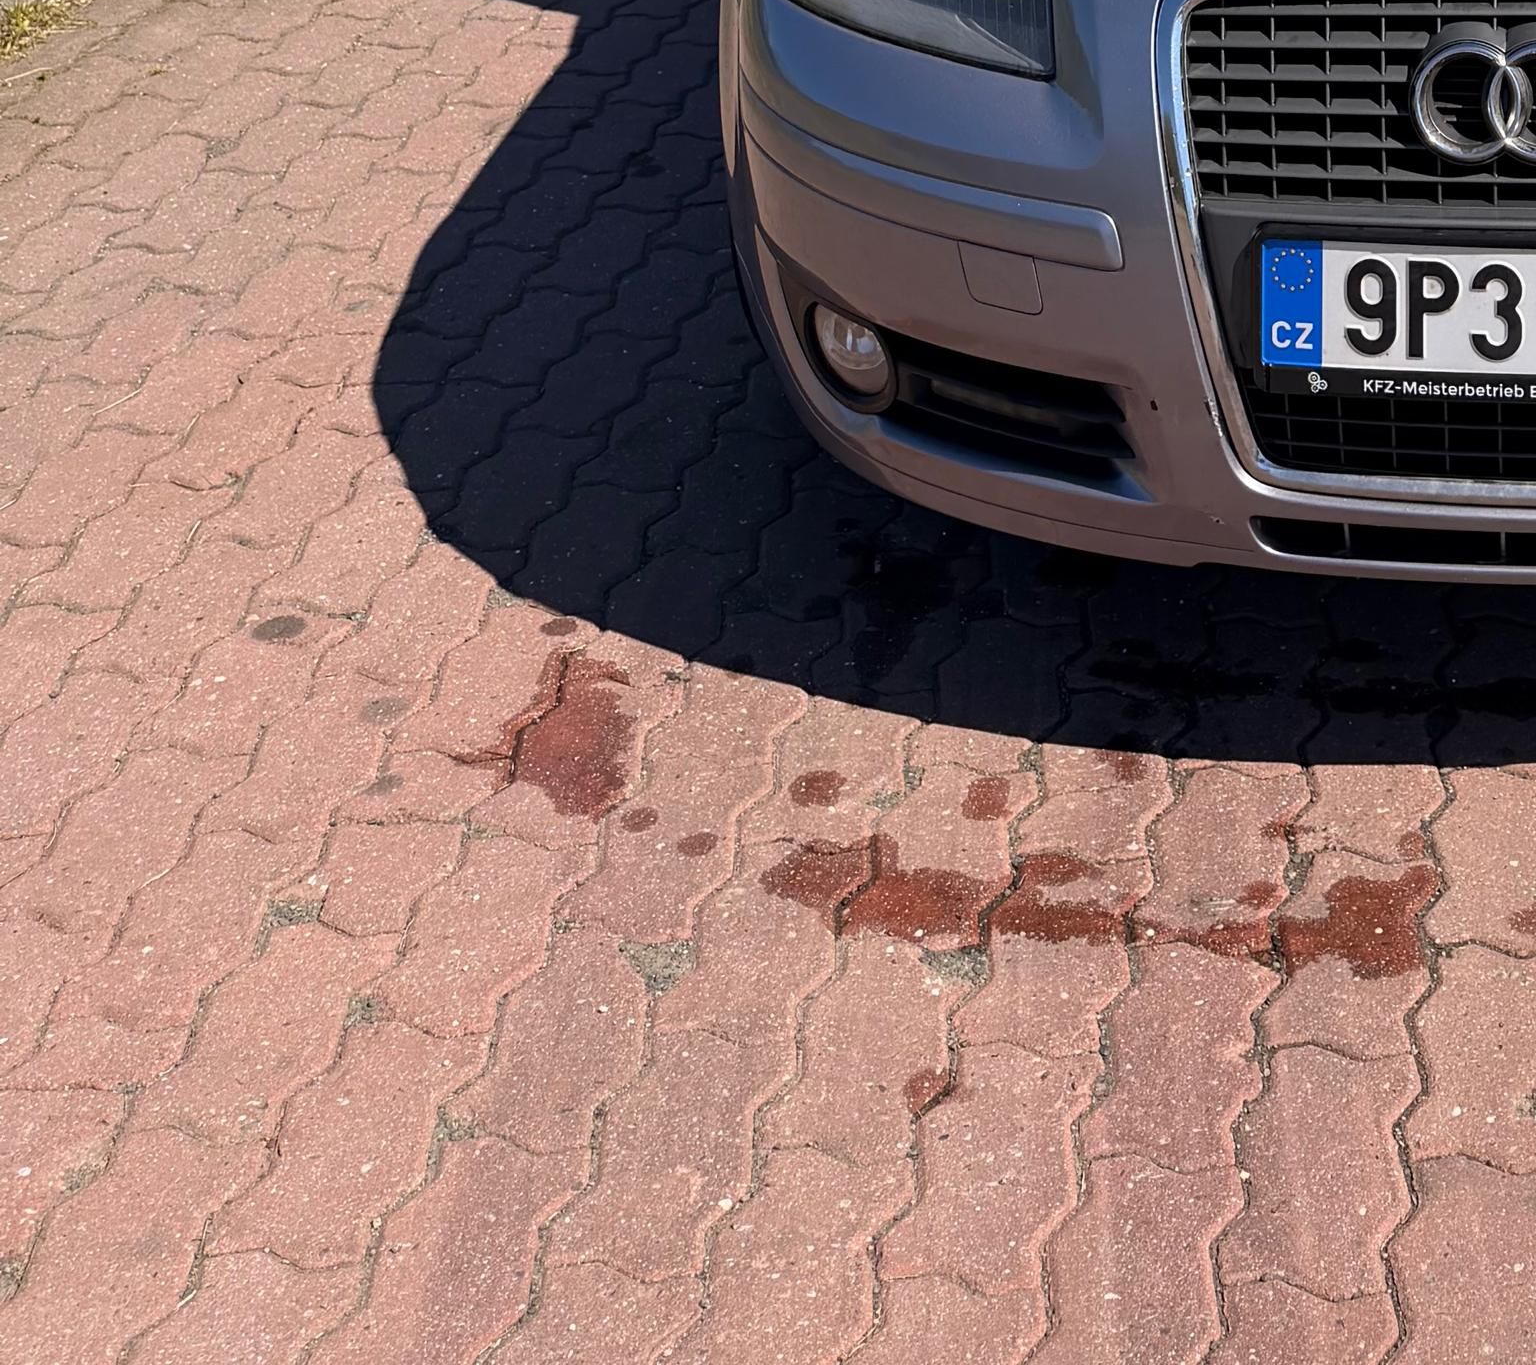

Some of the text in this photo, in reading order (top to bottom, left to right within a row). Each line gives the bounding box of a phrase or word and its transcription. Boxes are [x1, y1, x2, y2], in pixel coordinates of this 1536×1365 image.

[1343, 257, 1524, 362] 9P3
[1271, 320, 1314, 350] CZ
[1363, 379, 1525, 399] KFZ-Meisterbetrieb
